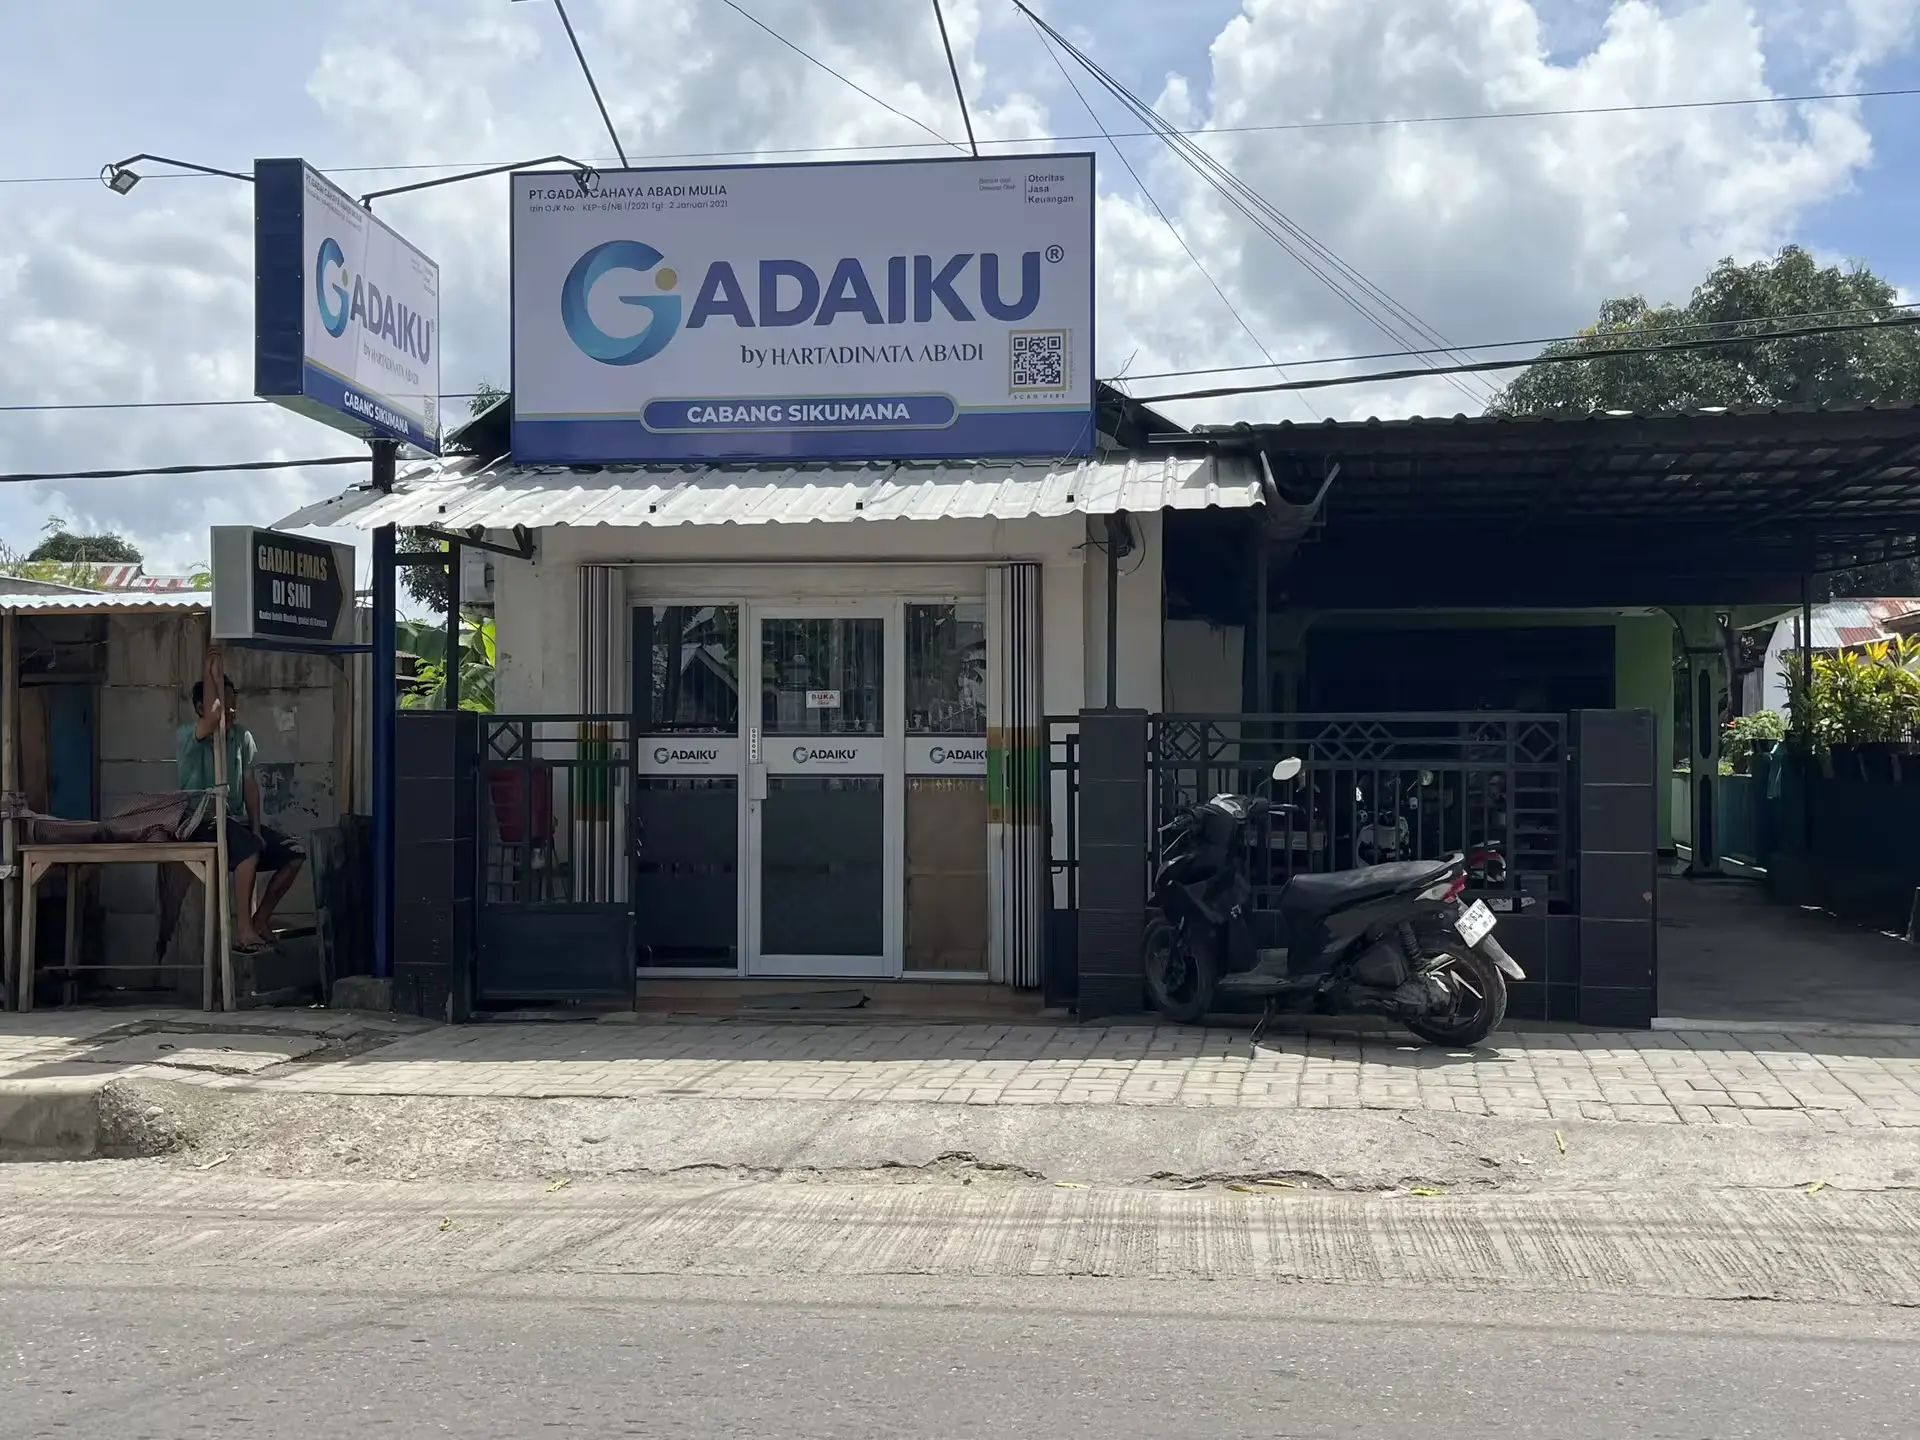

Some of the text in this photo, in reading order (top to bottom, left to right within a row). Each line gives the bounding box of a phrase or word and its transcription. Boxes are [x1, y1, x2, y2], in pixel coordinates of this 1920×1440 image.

[1028, 173, 1065, 183] Otoritas
[529, 185, 727, 200] PT.GADA CAHAYA ABADI MULIA
[1028, 185, 1050, 193] Jasa
[545, 204, 562, 212] OJK
[710, 200, 728, 208] 2021
[1028, 195, 1074, 205] Keuangan
[740, 342, 984, 368] by HARTADINATA ABADI
[344, 390, 409, 436] CABANG SIKUMANA
[686, 402, 910, 424] CABANG SIKUMANA
[258, 544, 328, 581] GADAI EMAS
[272, 579, 312, 609] DI SINI
[811, 693, 835, 701] BUKA
